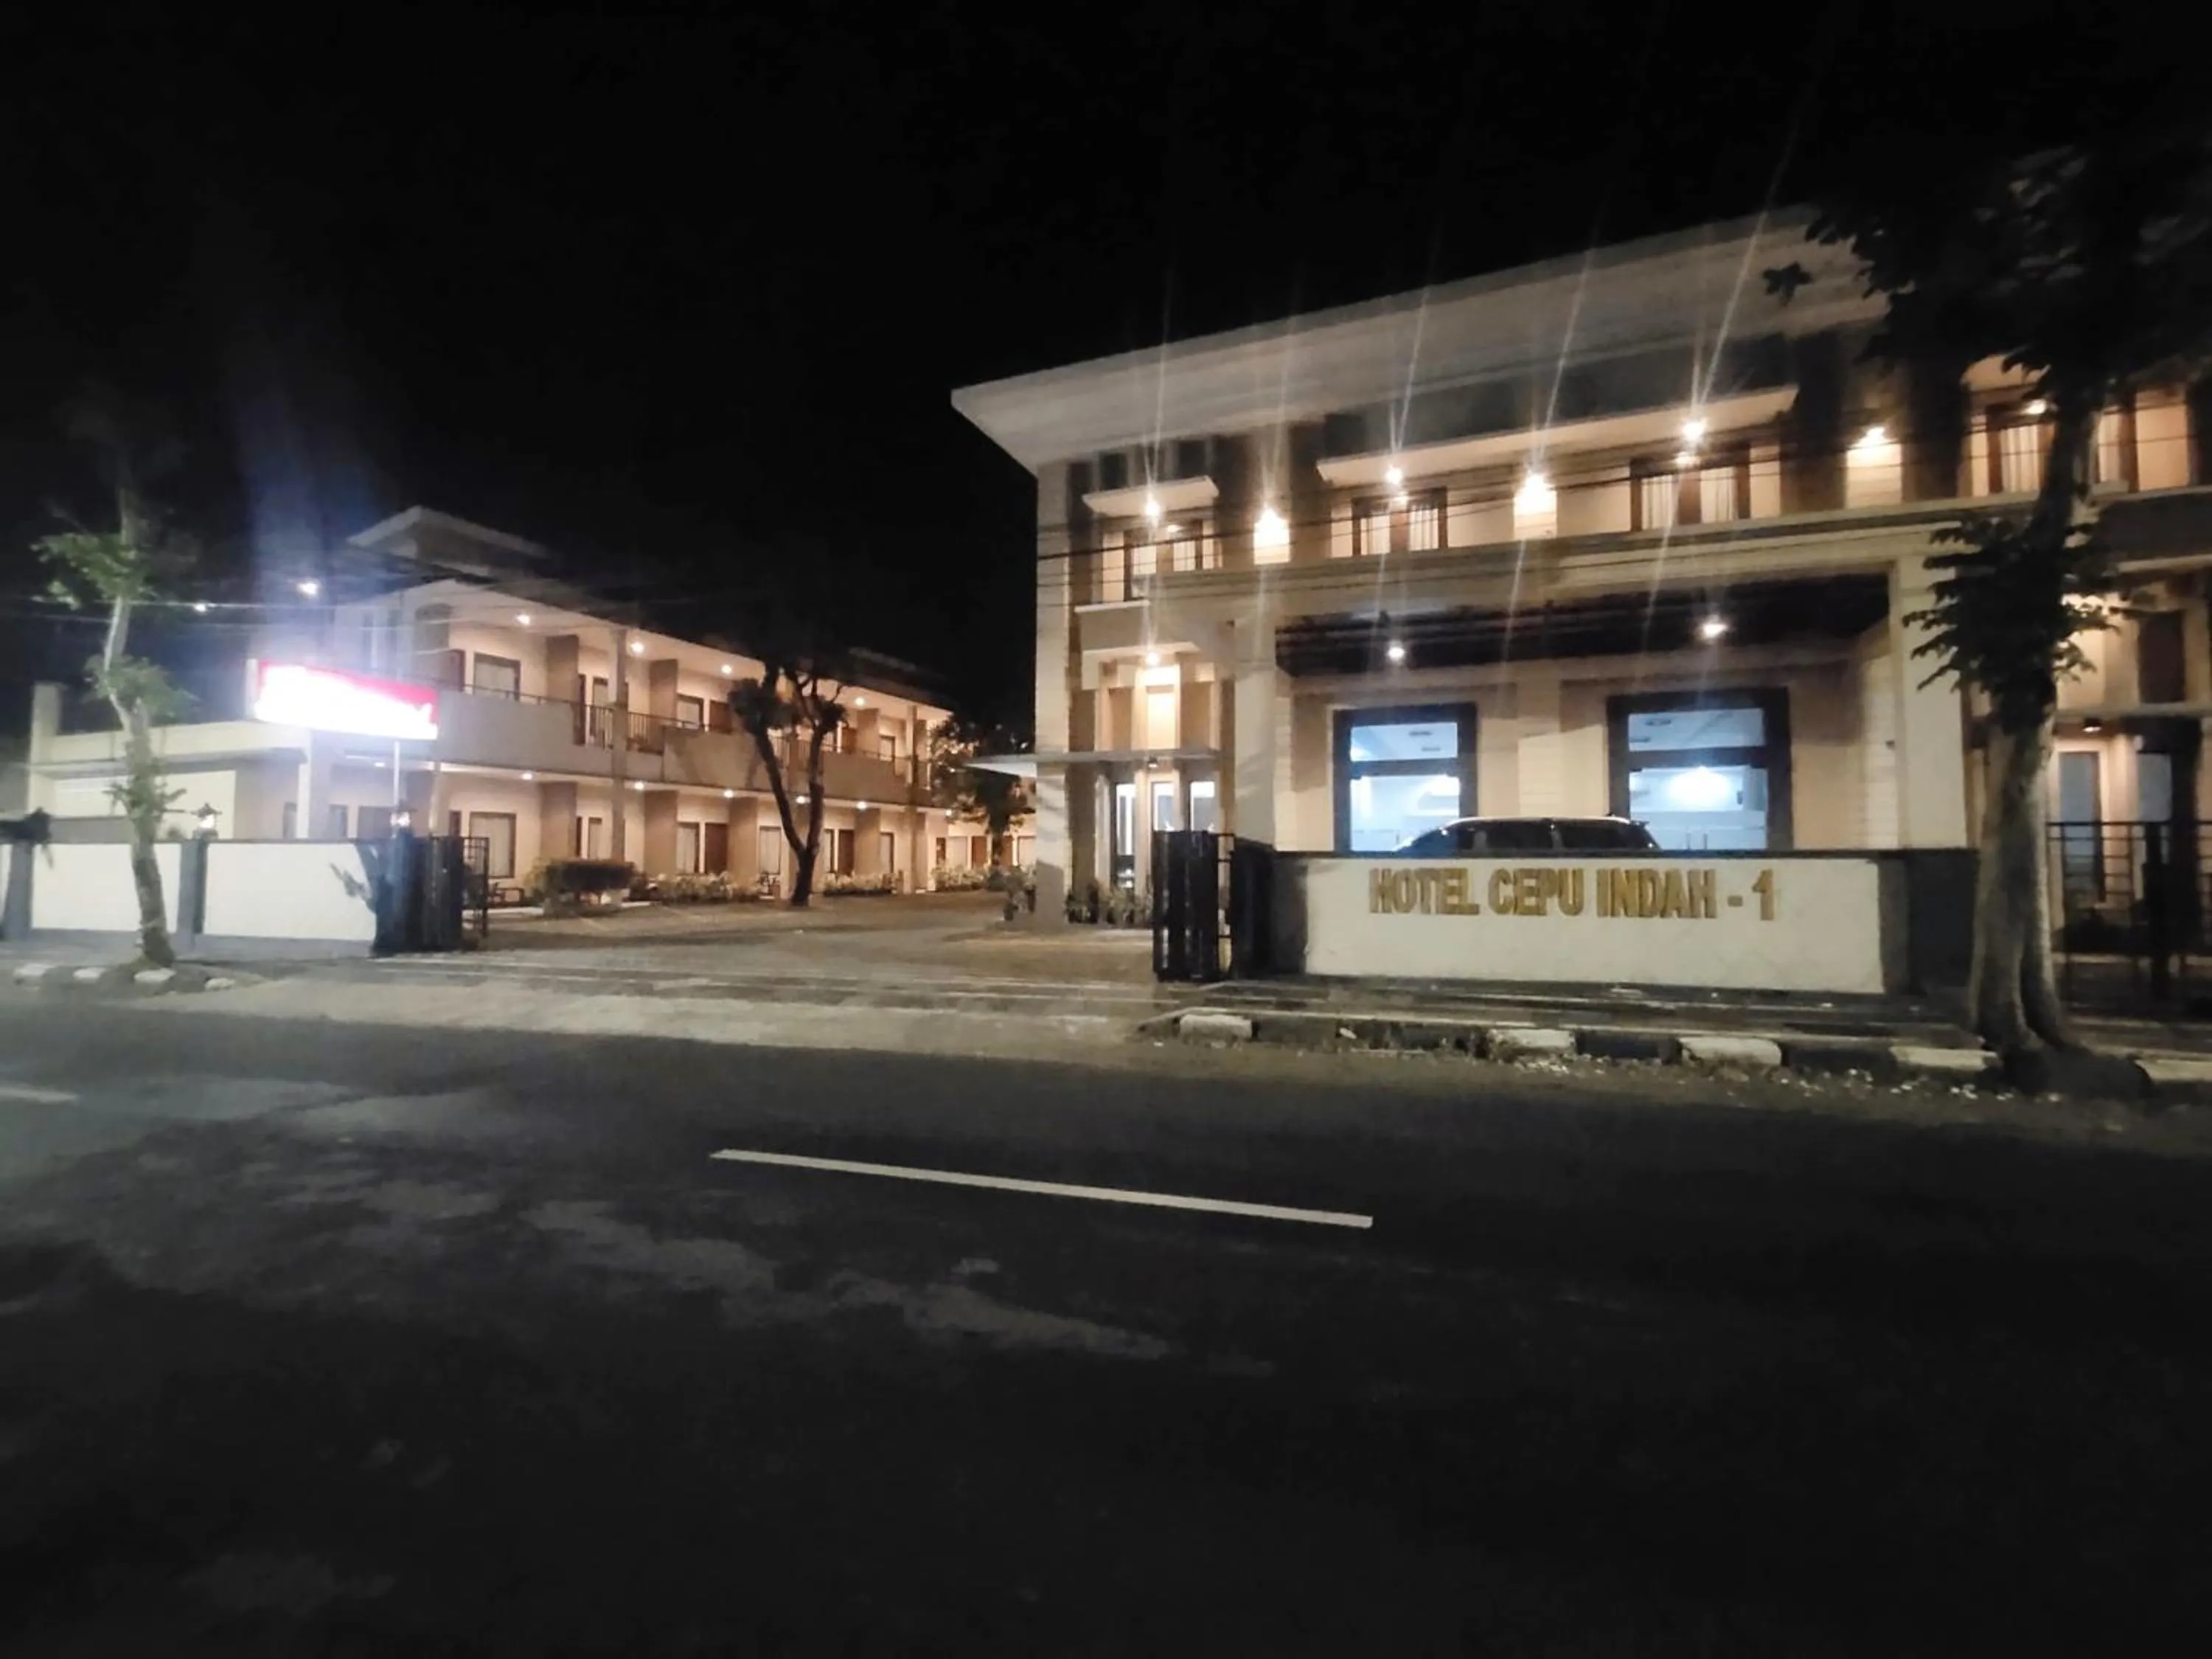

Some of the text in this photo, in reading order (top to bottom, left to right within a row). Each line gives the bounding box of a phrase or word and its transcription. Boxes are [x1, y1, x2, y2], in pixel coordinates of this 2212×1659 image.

[1368, 868, 1480, 915] HOTEL
[1488, 868, 1585, 917] CEPU
[1596, 869, 1717, 919] INDAH
